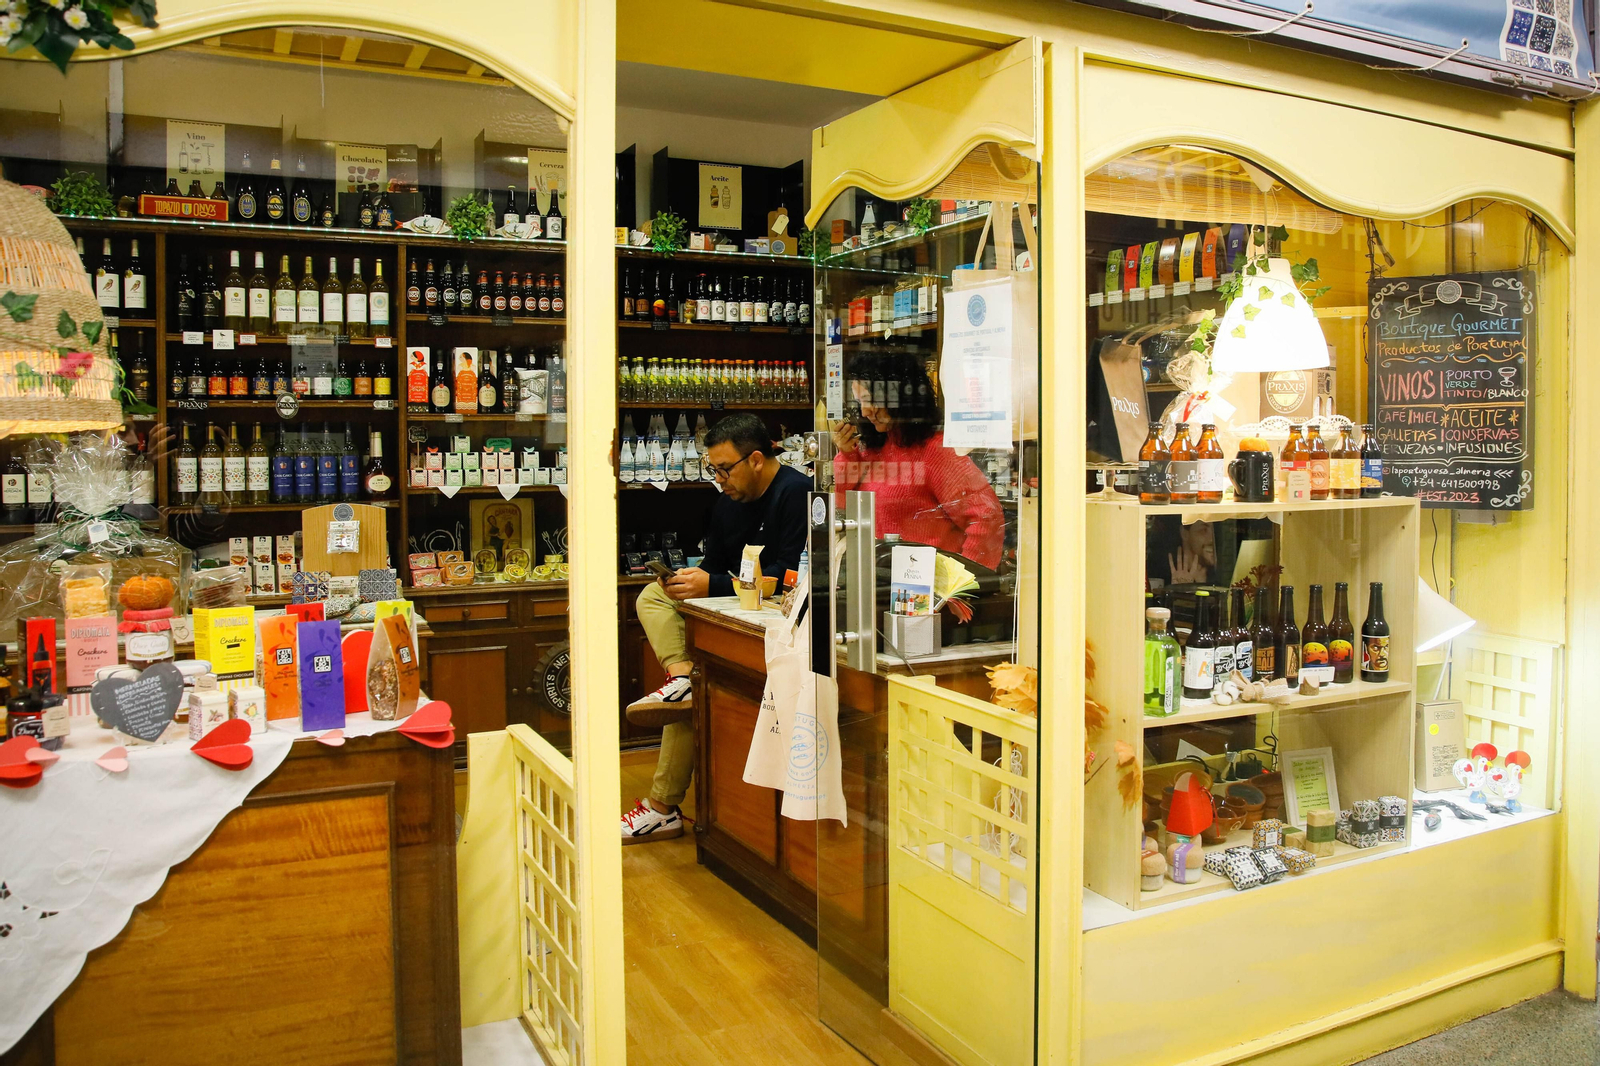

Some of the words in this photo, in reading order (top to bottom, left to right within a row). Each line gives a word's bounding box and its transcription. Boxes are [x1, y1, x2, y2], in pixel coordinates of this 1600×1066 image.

[186, 132, 206, 141] Vino
[342, 155, 383, 164] Chocolates
[539, 161, 565, 169] Cerveza
[710, 174, 730, 182] Aceite
[154, 200, 181, 215] TOPAZIO
[193, 202, 217, 217] ONYX
[1376, 317, 1446, 341] Boutique
[1447, 341, 1462, 353] de
[1445, 369, 1493, 381] PORTO
[1267, 381, 1305, 393] PRAXIS
[1379, 369, 1436, 402] VINOS
[1445, 380, 1477, 389] VERDE
[178, 400, 208, 410] PRAXIS
[1111, 396, 1140, 419] PRAXIS
[1377, 407, 1406, 424] CAFÉ
[1412, 411, 1439, 425] MIEL
[1451, 408, 1507, 428] ACEITE
[1377, 426, 1437, 444] GALLETAS
[1444, 427, 1520, 441] CONSERVAS
[1445, 442, 1523, 455] INFUSIONES
[214, 616, 249, 628] DIPLOMATA
[71, 626, 111, 639] DIPLOMATA
[219, 636, 247, 645] Crackers
[77, 647, 108, 656] Crackers
[546, 674, 565, 708] SPIRITS
